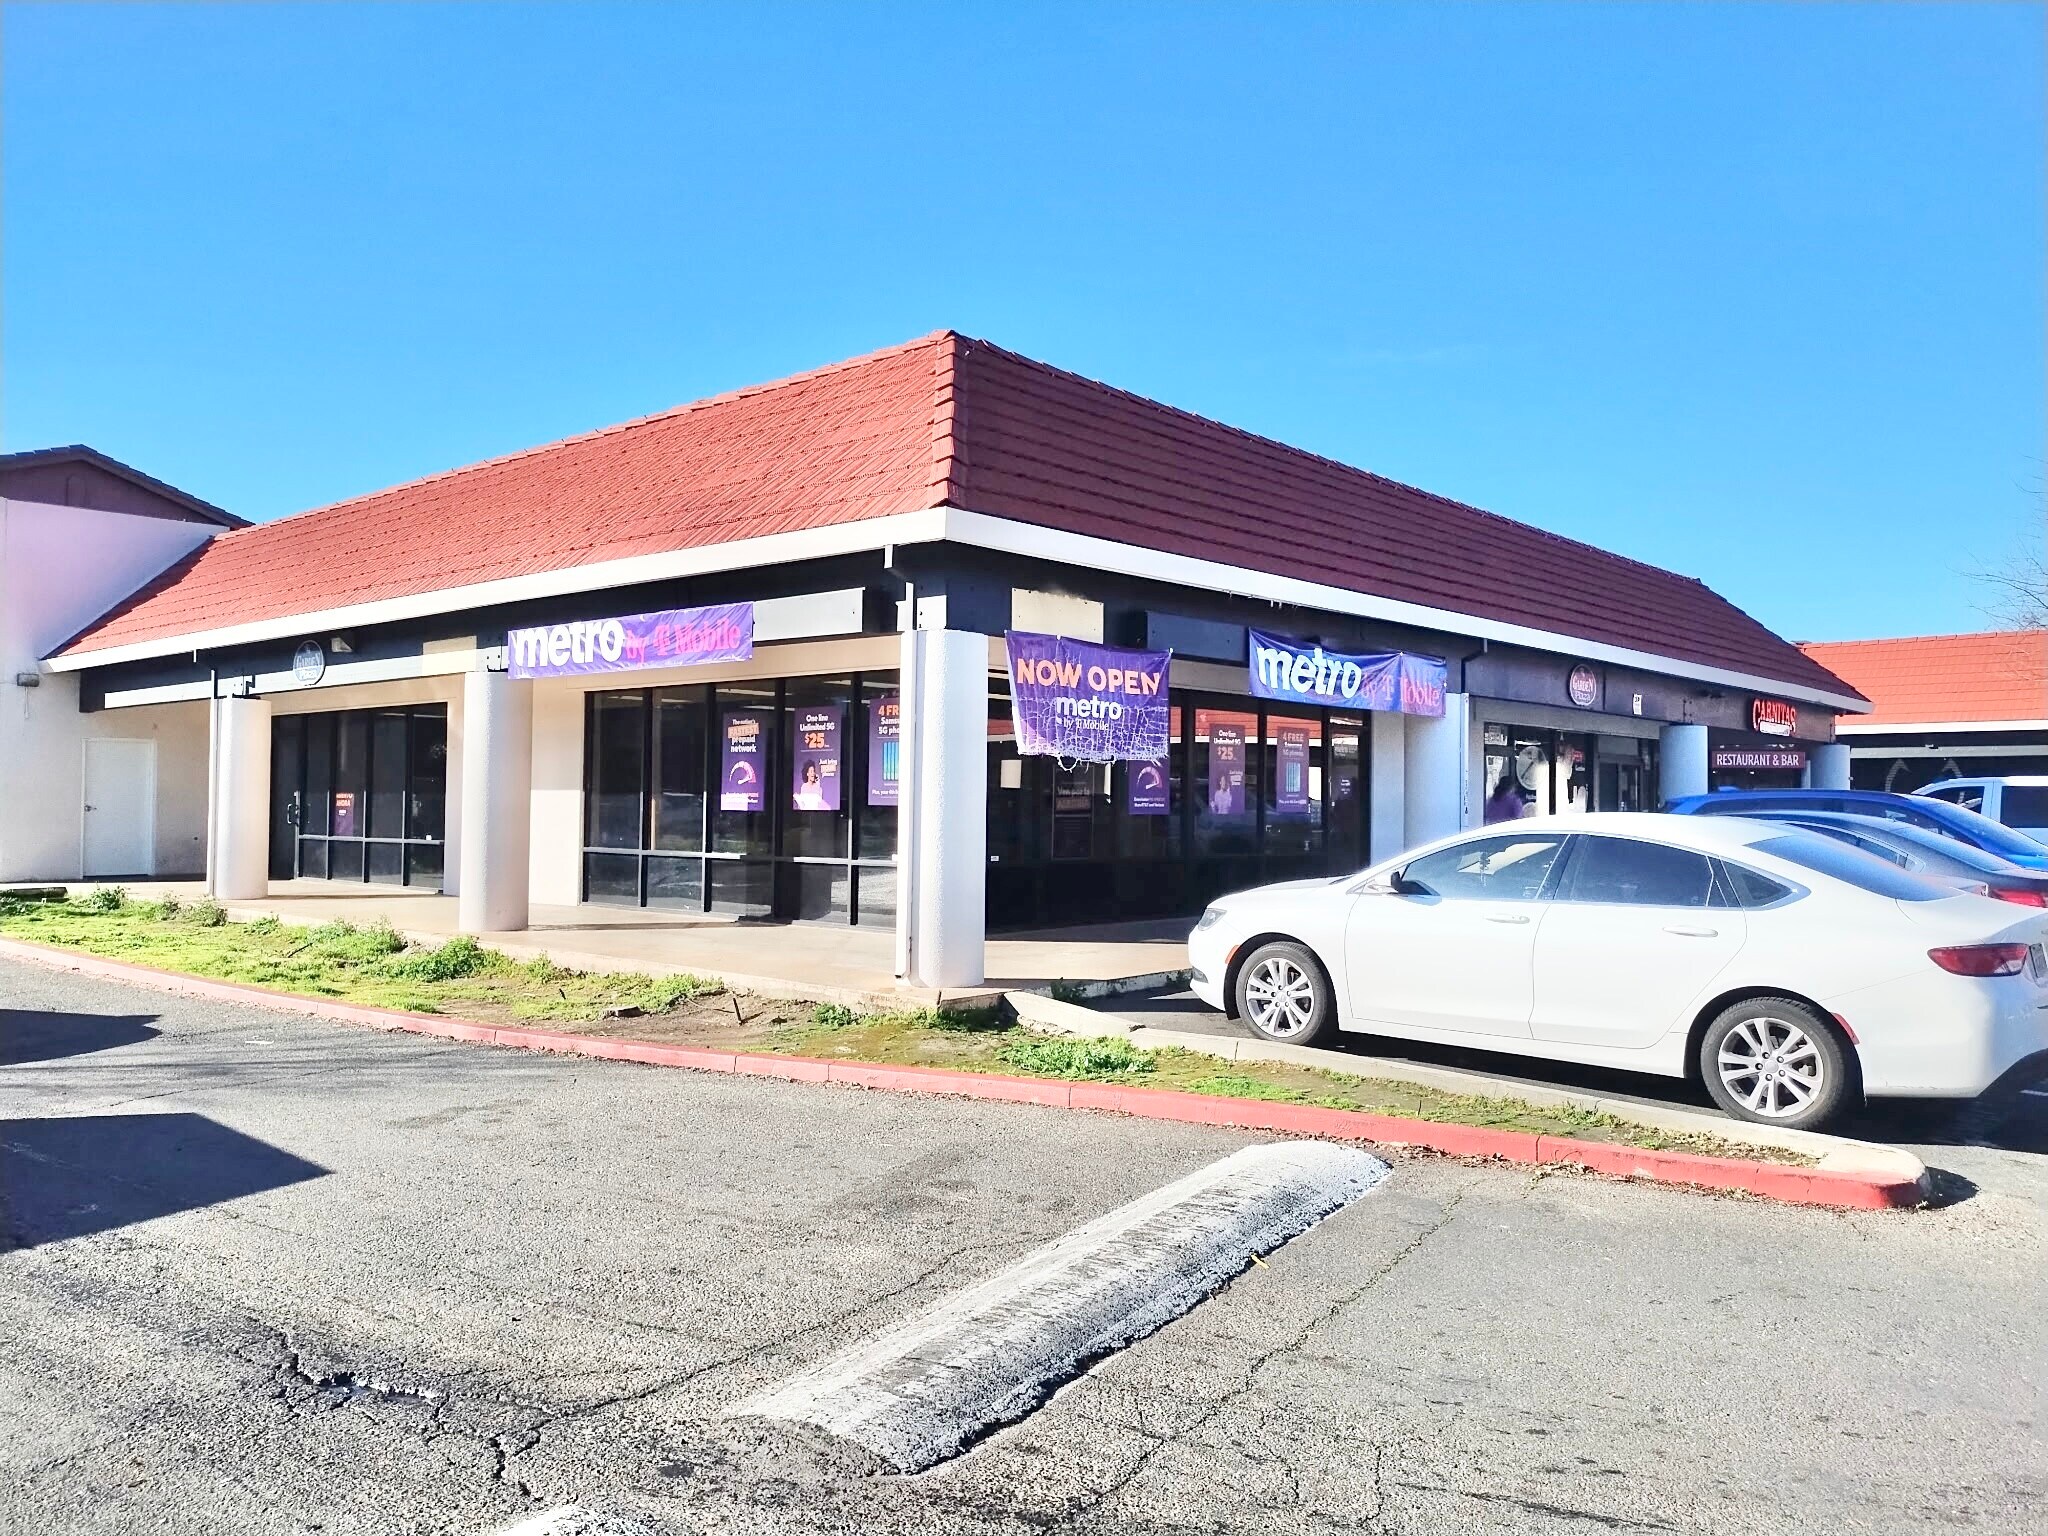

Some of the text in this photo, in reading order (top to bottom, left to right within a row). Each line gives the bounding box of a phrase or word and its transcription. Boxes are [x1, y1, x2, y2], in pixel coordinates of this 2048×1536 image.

[513, 620, 625, 668] metro
[626, 630, 645, 668] by
[675, 618, 741, 655] Mobile
[1017, 658, 1160, 695] NOW OPEN
[1256, 648, 1362, 698] metro
[878, 704, 899, 716] 4 FR
[1056, 695, 1122, 719] metro
[1752, 699, 1796, 733] CARNITAS
[799, 722, 825, 732] Unlimited
[730, 744, 757, 753] network
[1717, 754, 1799, 766] RESTAURANT & BAR
